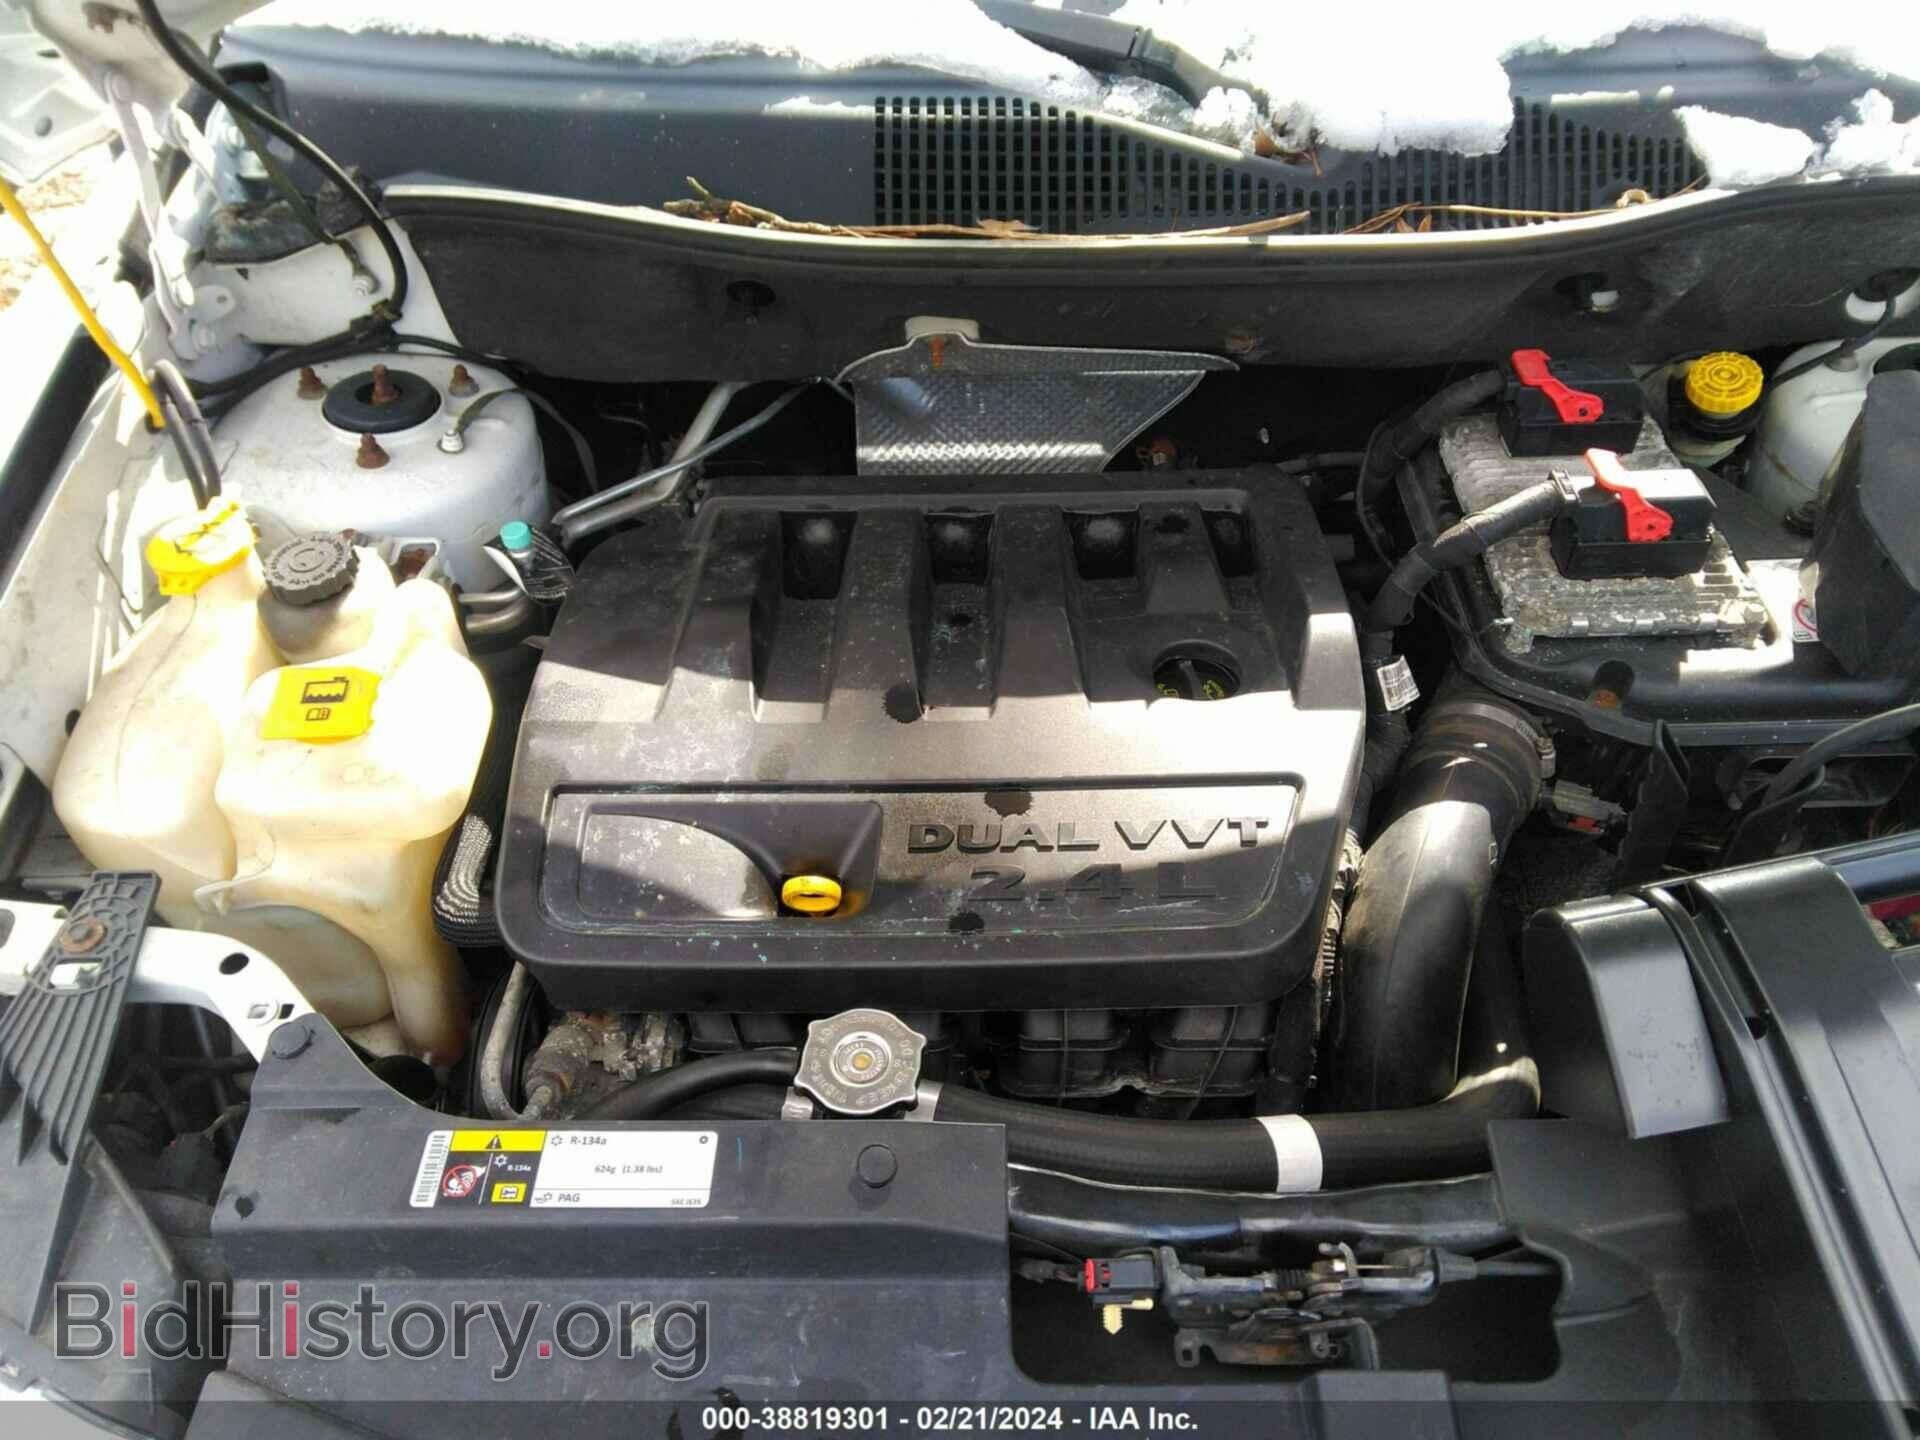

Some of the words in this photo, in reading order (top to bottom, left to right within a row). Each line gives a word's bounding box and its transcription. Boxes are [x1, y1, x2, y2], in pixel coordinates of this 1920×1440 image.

[907, 820, 1100, 855] DUAL
[1113, 816, 1270, 850] VVT
[569, 1135, 607, 1147] R-134a
[557, 1191, 581, 1204] PAG
